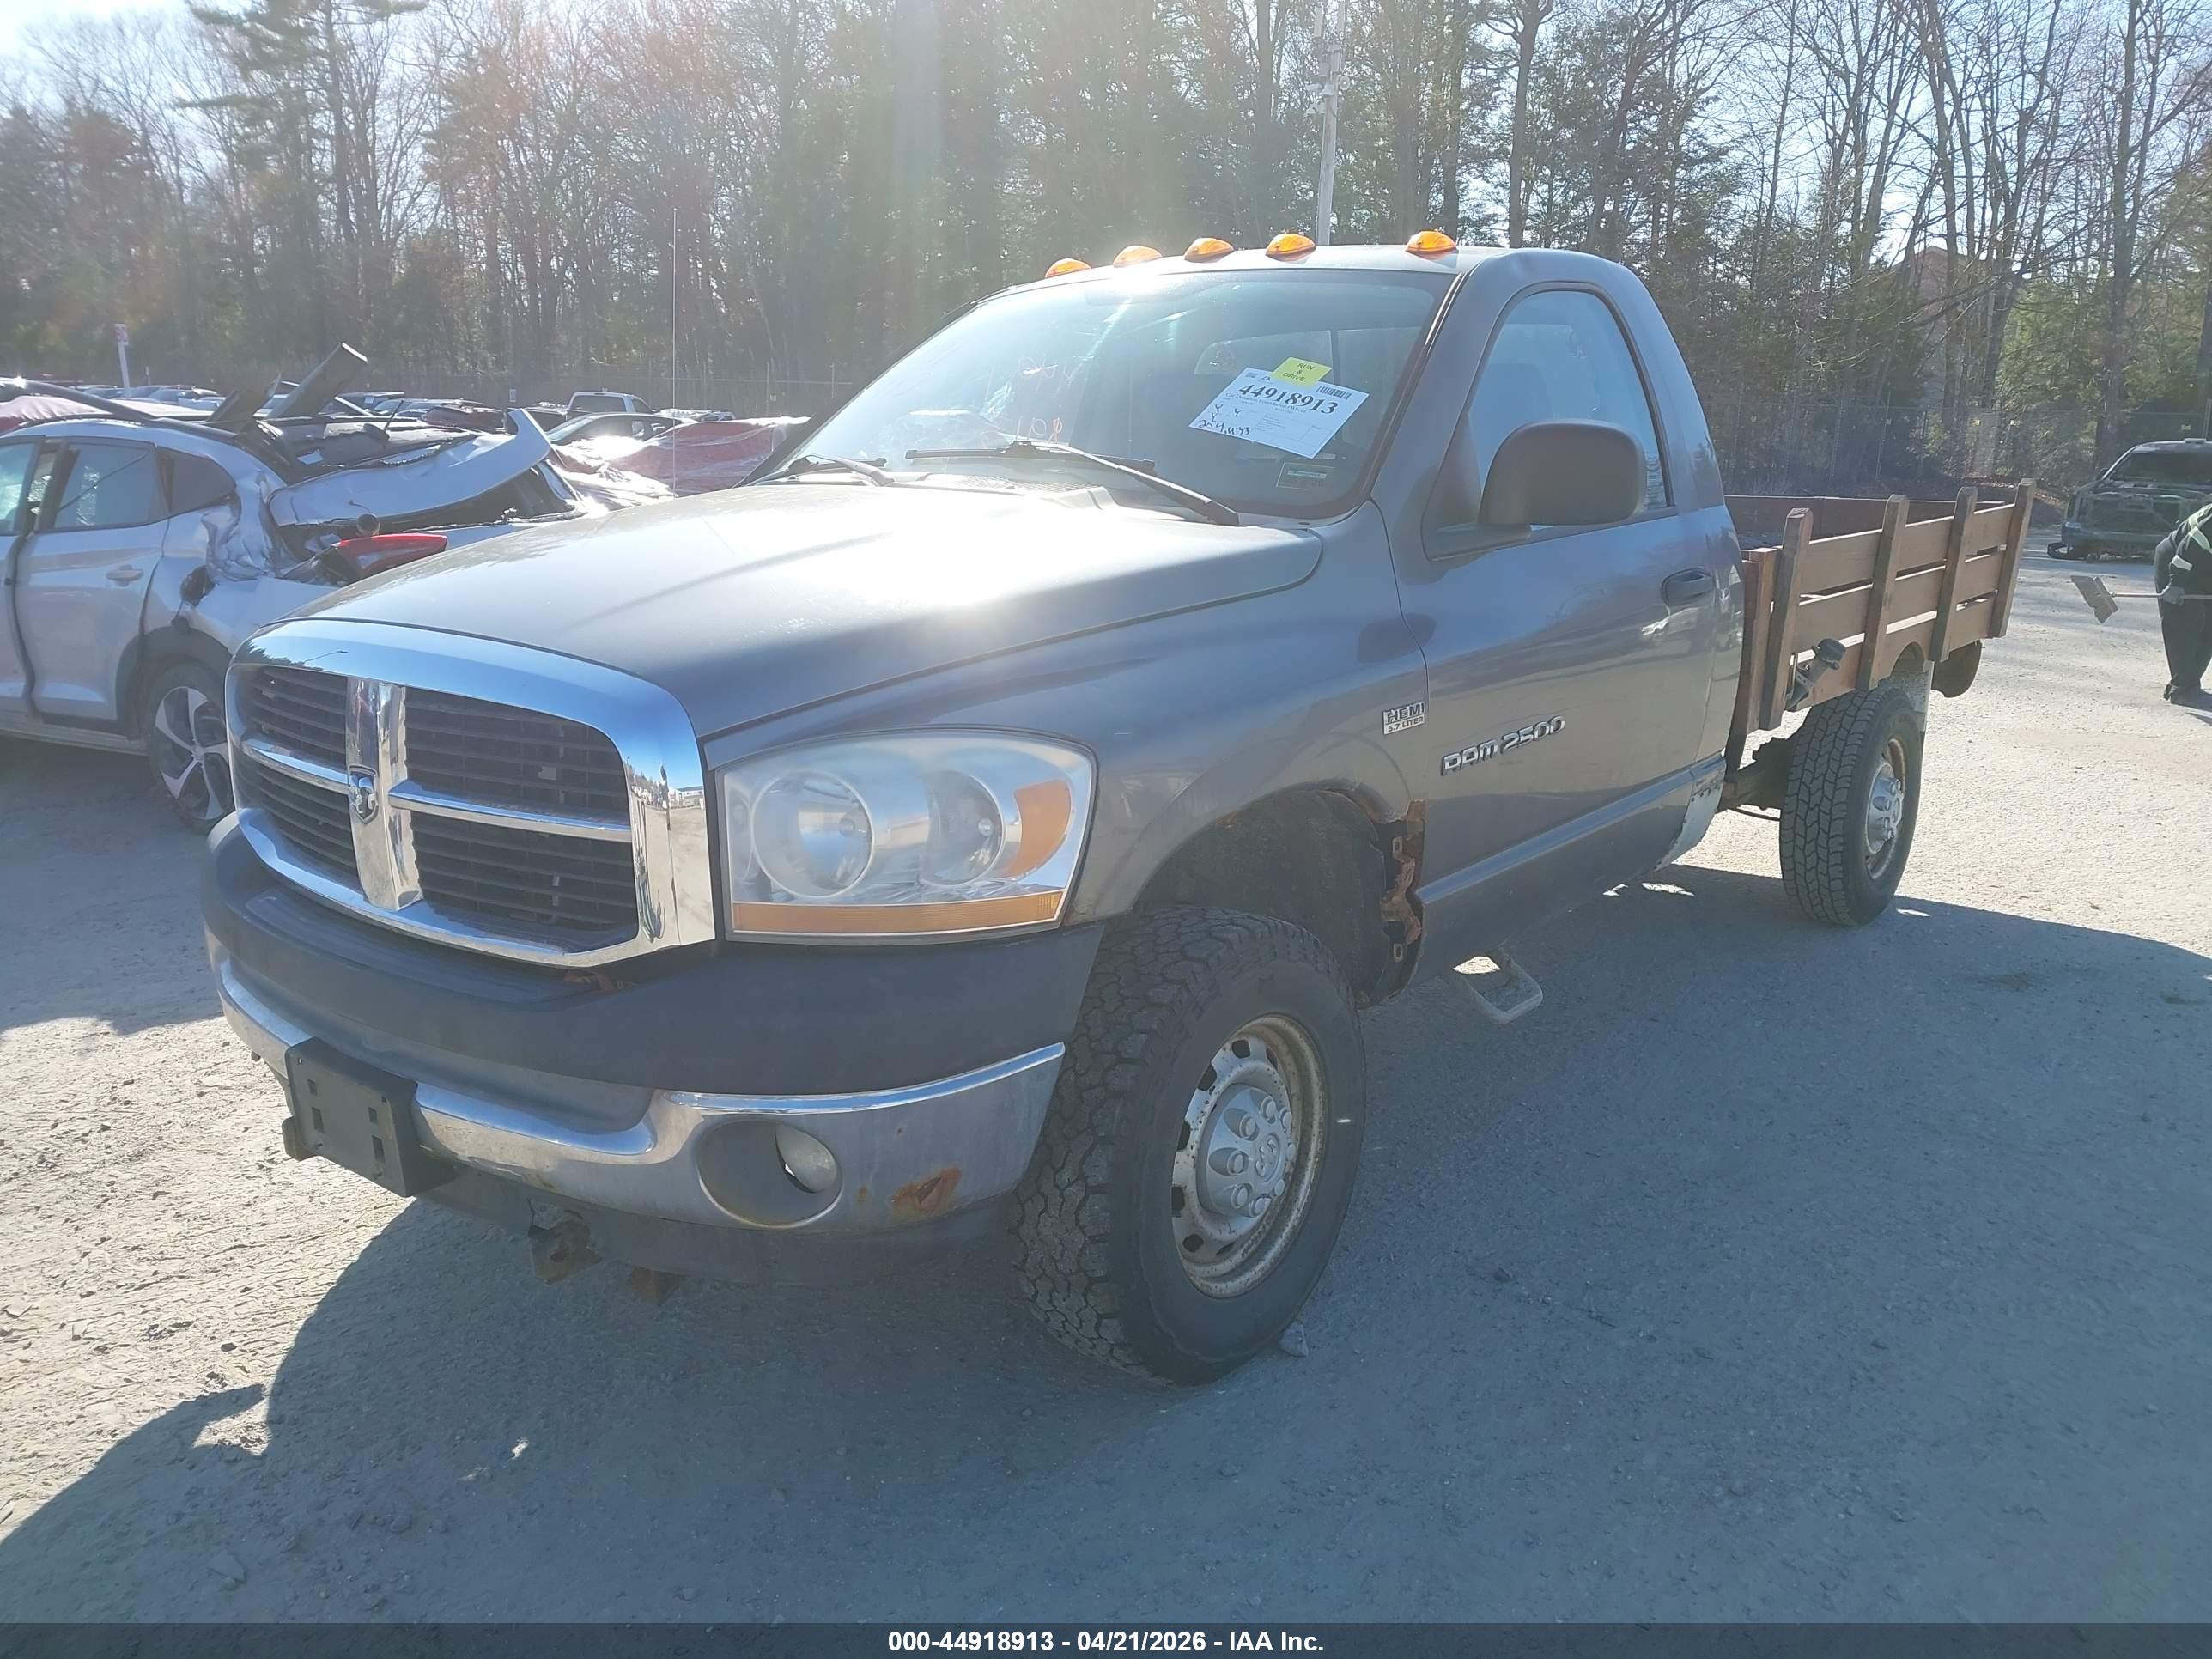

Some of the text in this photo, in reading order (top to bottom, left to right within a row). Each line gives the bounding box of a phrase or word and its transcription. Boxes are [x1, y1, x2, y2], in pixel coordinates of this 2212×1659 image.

[1297, 362, 1315, 371] RUN
[1282, 373, 1305, 382] DRIVE
[1239, 384, 1339, 415] 44918913
[1385, 702, 1425, 724] HEMI
[1388, 716, 1425, 732] 5.7 LITER
[1441, 715, 1565, 775] RAM 2500
